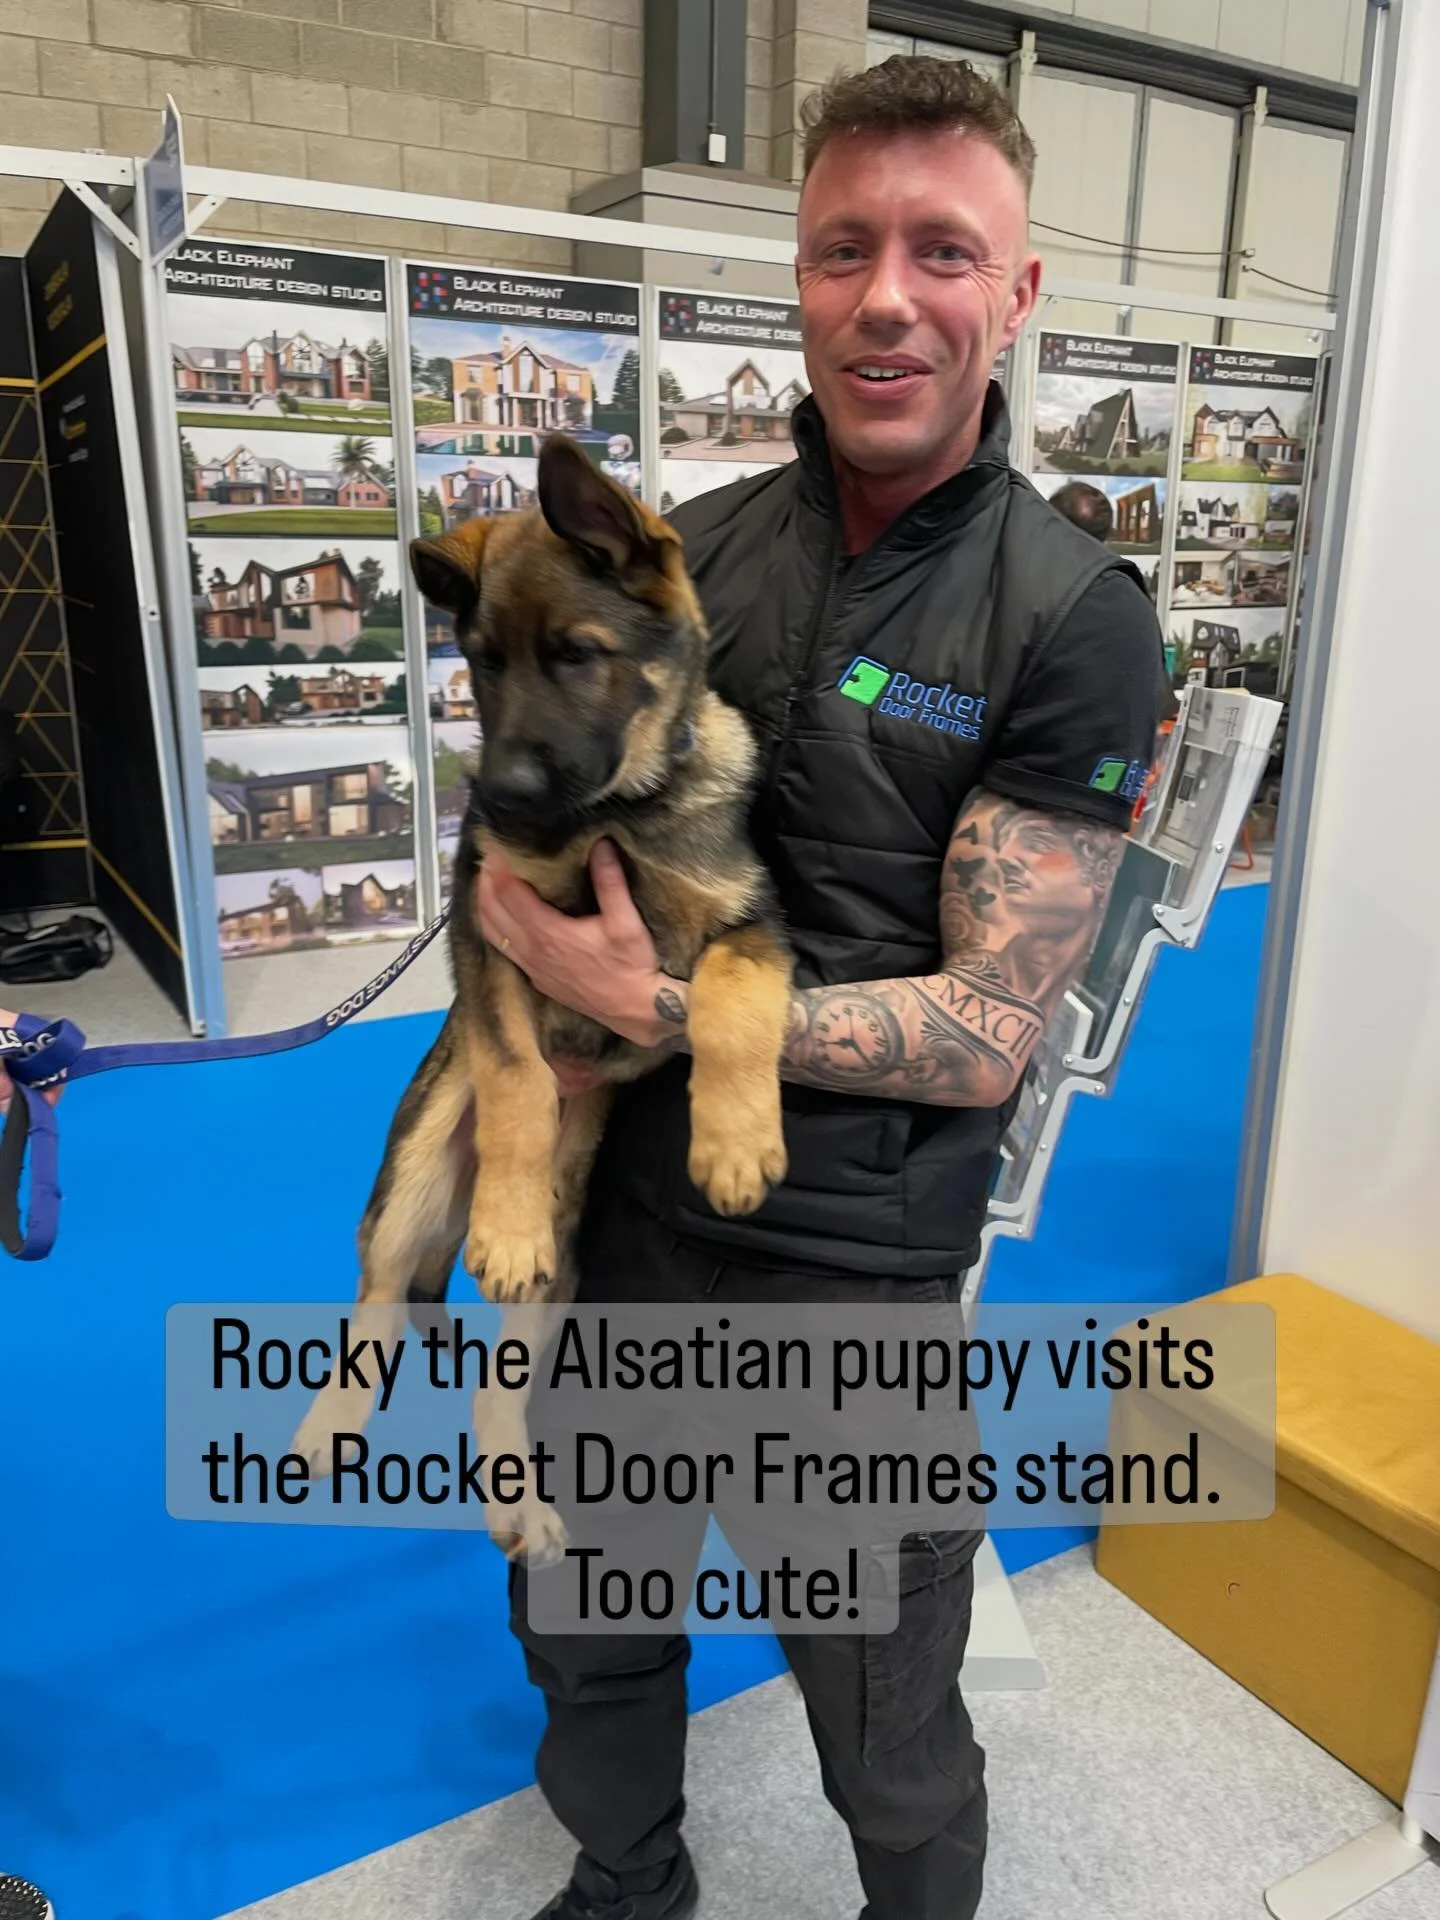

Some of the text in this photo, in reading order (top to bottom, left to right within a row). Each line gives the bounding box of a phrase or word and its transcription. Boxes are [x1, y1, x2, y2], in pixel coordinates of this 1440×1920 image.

[217, 250, 295, 270] ELEPHANT
[165, 268, 382, 301] ARCHITECTURE DESIGN STUDIO
[453, 276, 565, 299] BLACK ELEPHANT
[453, 297, 637, 326] ARCHITECTURE DESIGN STUDIO
[696, 301, 789, 322] BLACK ELEPHANT
[1066, 339, 1093, 353] BLACK
[1214, 353, 1238, 365] BLACK
[886, 672, 988, 723] Rocket
[878, 697, 980, 740] Door Frames
[326, 990, 365, 1026] DOG
